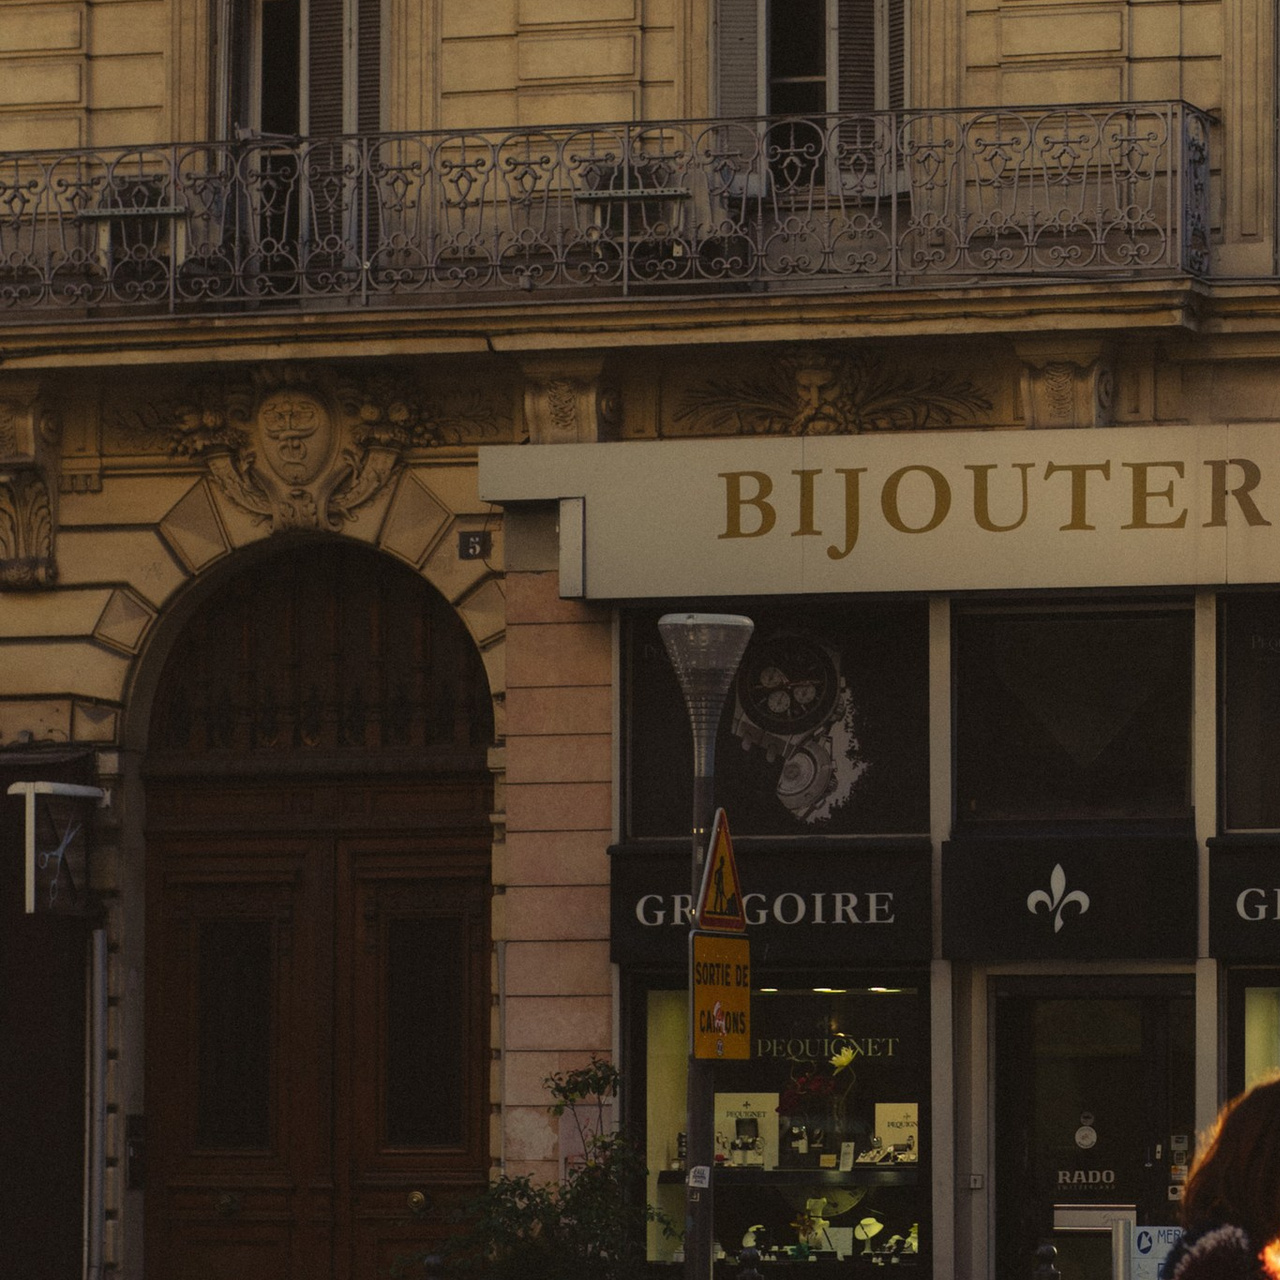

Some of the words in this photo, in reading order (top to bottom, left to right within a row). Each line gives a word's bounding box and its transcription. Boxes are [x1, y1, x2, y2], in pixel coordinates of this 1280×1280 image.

[468, 536, 481, 555] 5
[636, 892, 896, 926] GRGOIRE
[695, 961, 731, 987] SORTIE
[735, 964, 749, 987] DE
[699, 1009, 746, 1034] CAONS
[1057, 1169, 1116, 1184] RADO
